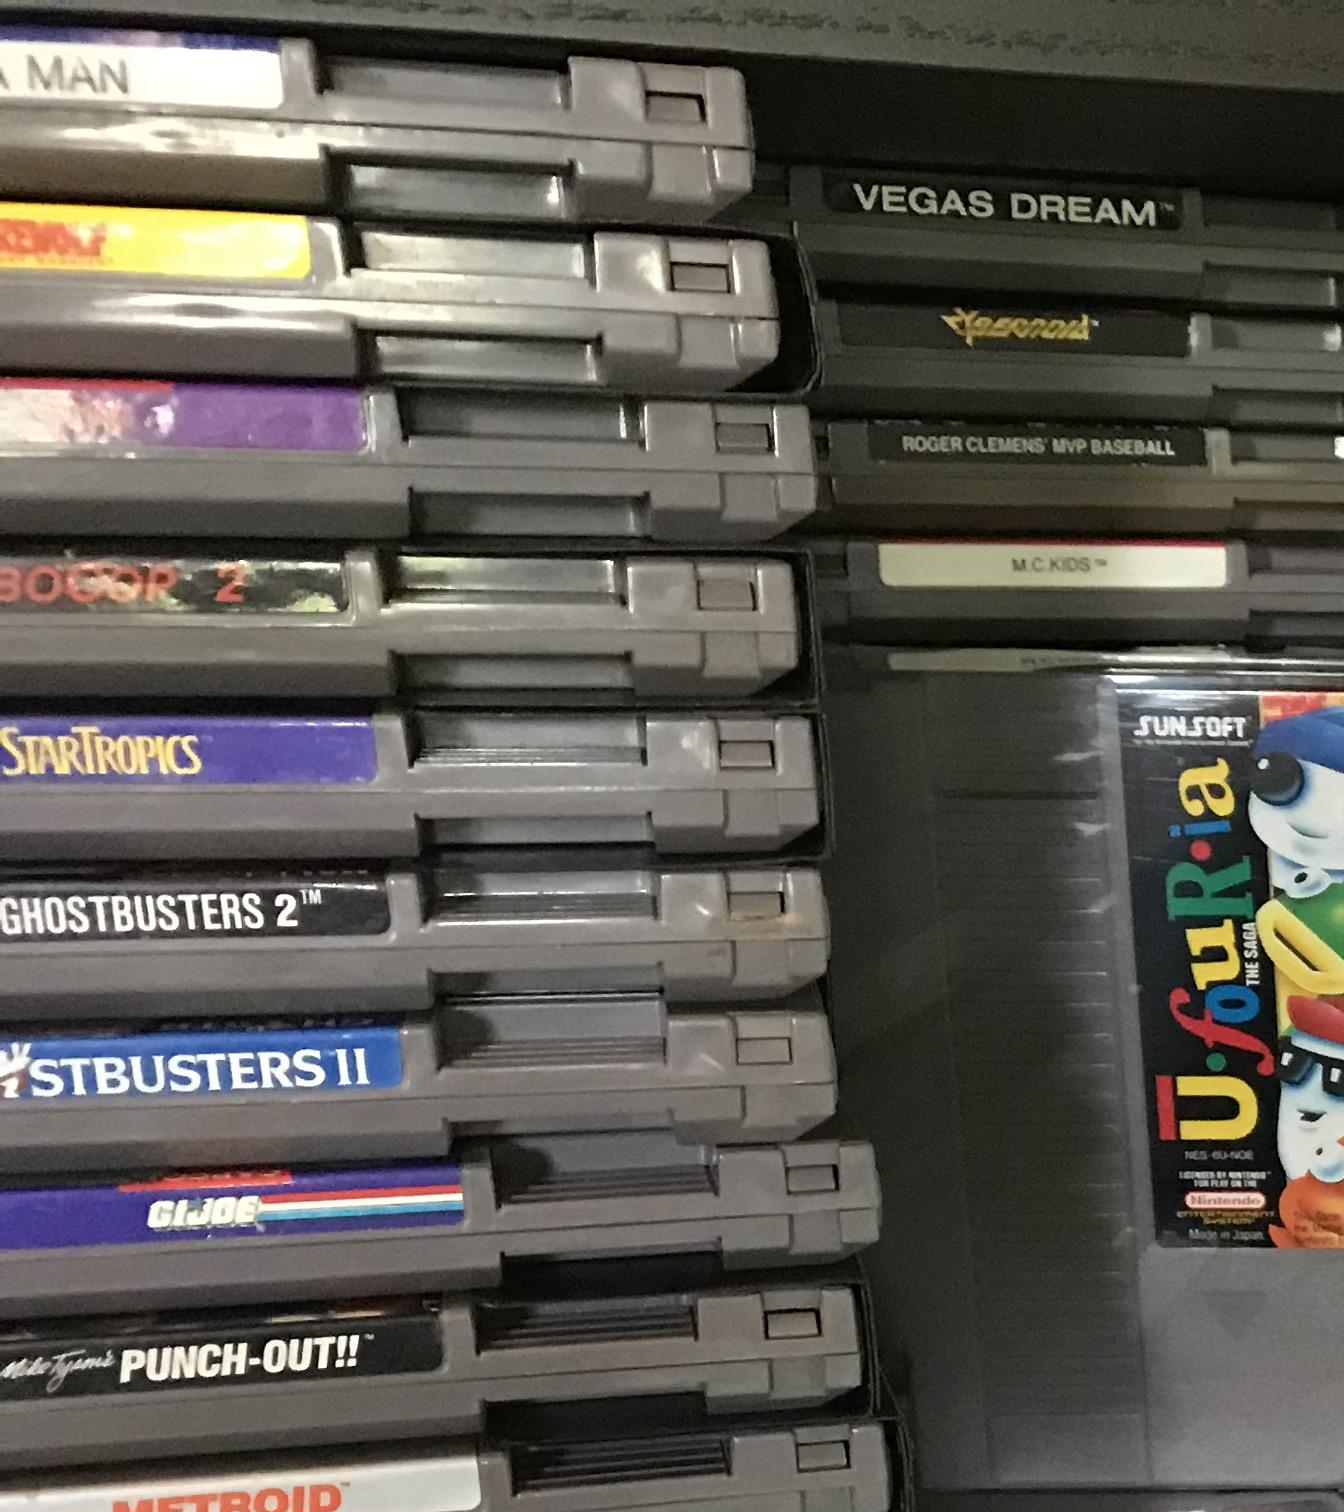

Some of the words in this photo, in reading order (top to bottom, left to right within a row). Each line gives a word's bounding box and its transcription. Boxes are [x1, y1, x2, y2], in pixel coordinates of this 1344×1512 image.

[26, 55, 128, 95] MAN
[853, 183, 994, 219] VEGAS
[1010, 191, 1157, 228] DREAM
[902, 436, 963, 453] ROGER
[1052, 438, 1086, 455] MVP
[1091, 438, 1176, 457] BASEBALL
[216, 563, 246, 602] 2
[0, 893, 264, 935] GHOSTBUSTERS
[1244, 921, 1259, 958] SAGA
[1246, 960, 1261, 988] THE
[338, 1048, 369, 1086] II
[119, 1335, 361, 1383] PUNCH-OUT!!
